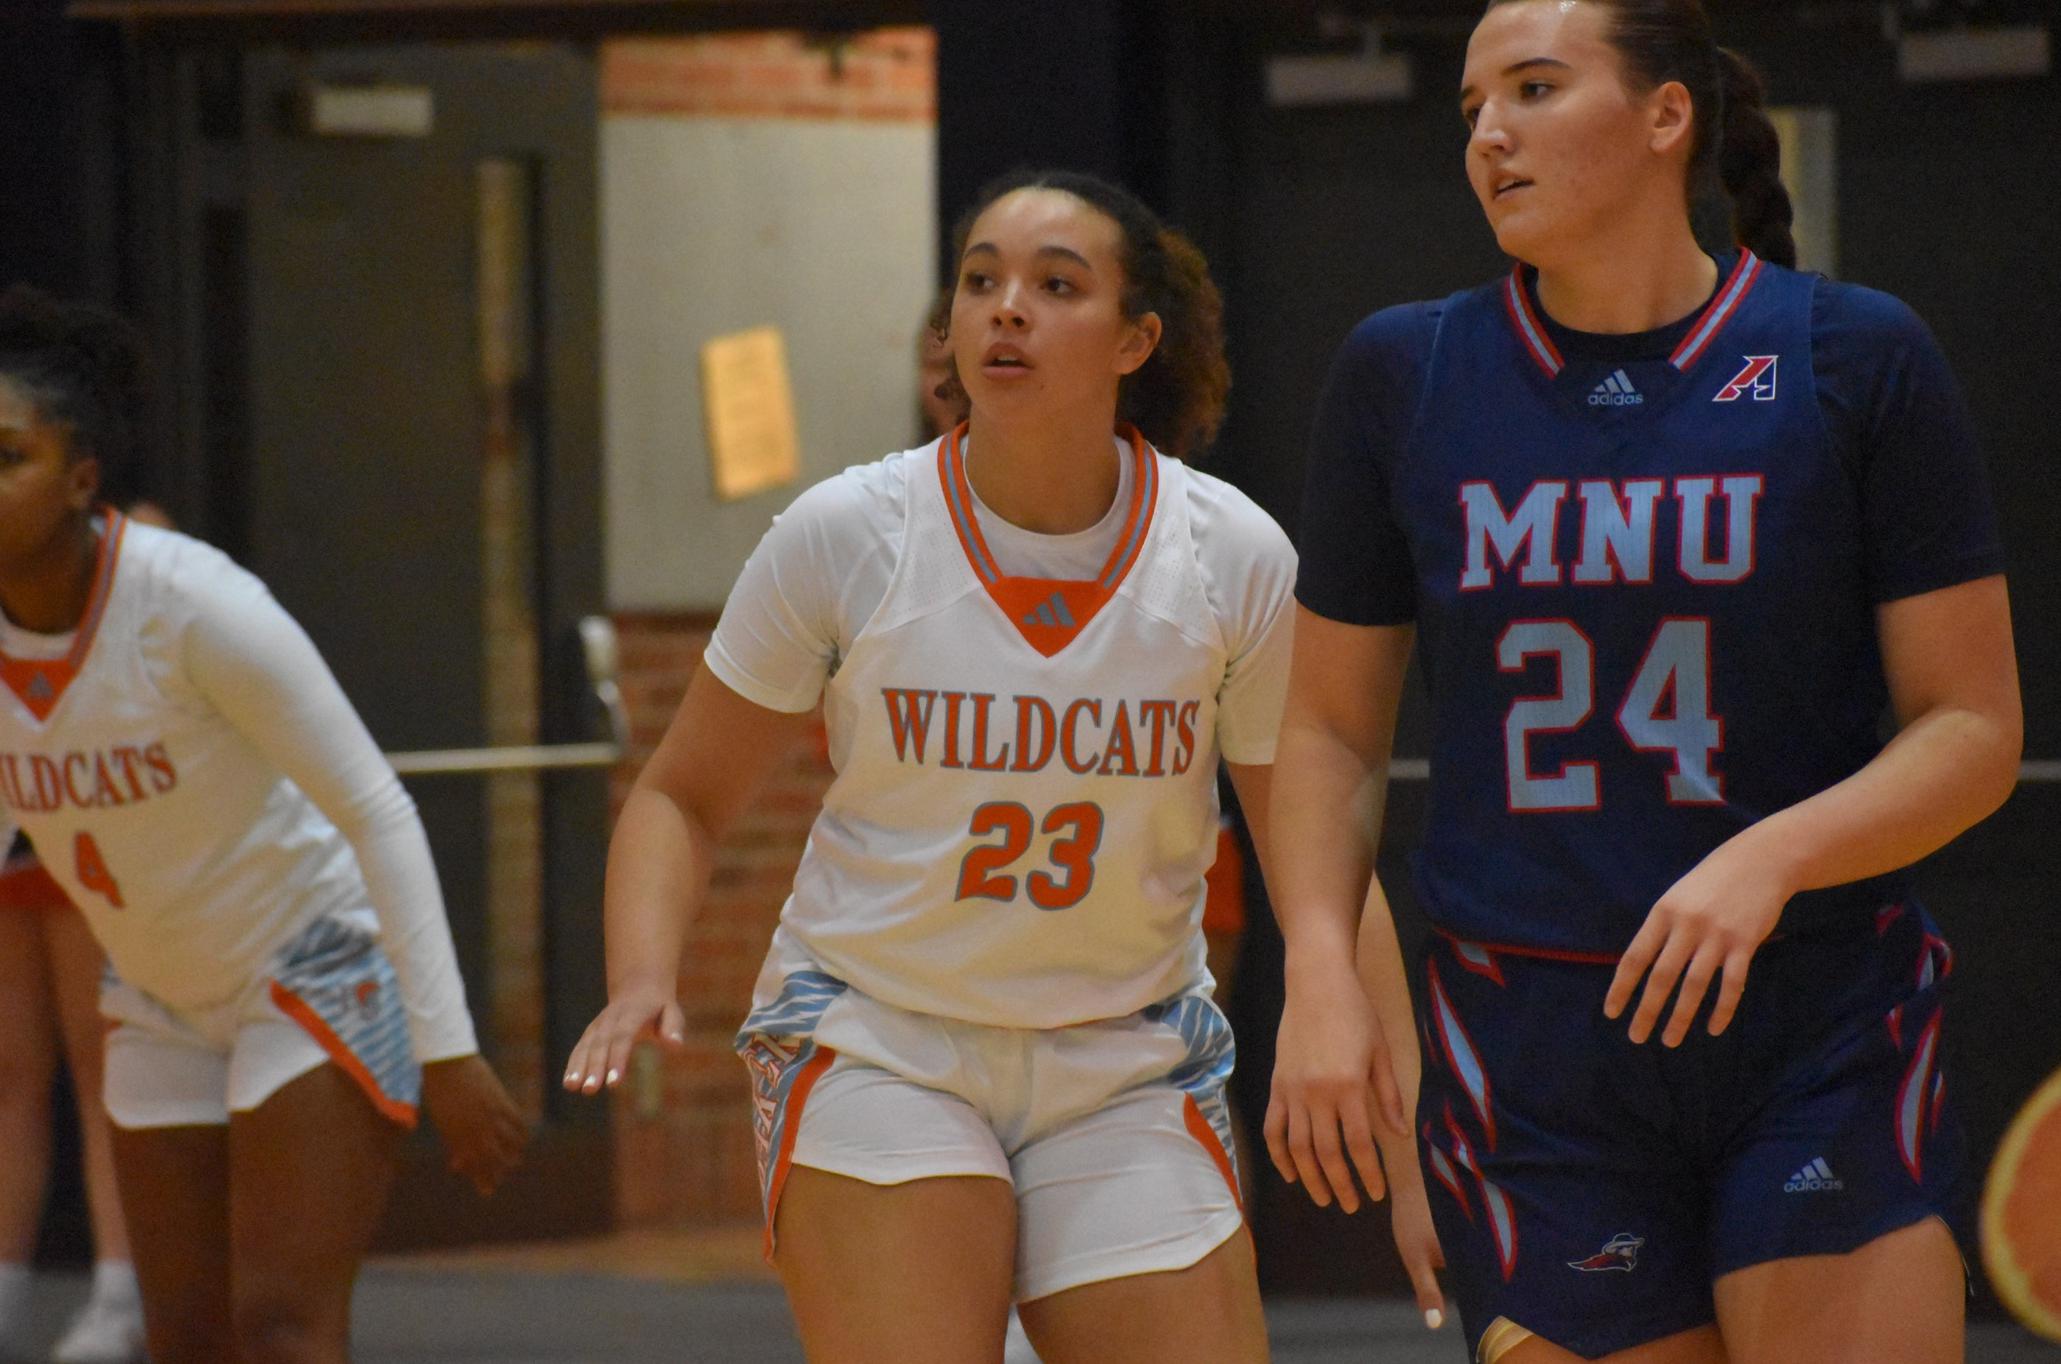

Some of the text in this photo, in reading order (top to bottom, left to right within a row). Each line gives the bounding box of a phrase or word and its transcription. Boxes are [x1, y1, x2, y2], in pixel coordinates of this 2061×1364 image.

[1587, 392, 1644, 406] adidas
[1460, 474, 1765, 590] MNU
[881, 687, 1200, 778] WILDCATS
[1496, 617, 1727, 812] 24
[953, 800, 1105, 912] 23
[1783, 1179, 1844, 1193] adidas
